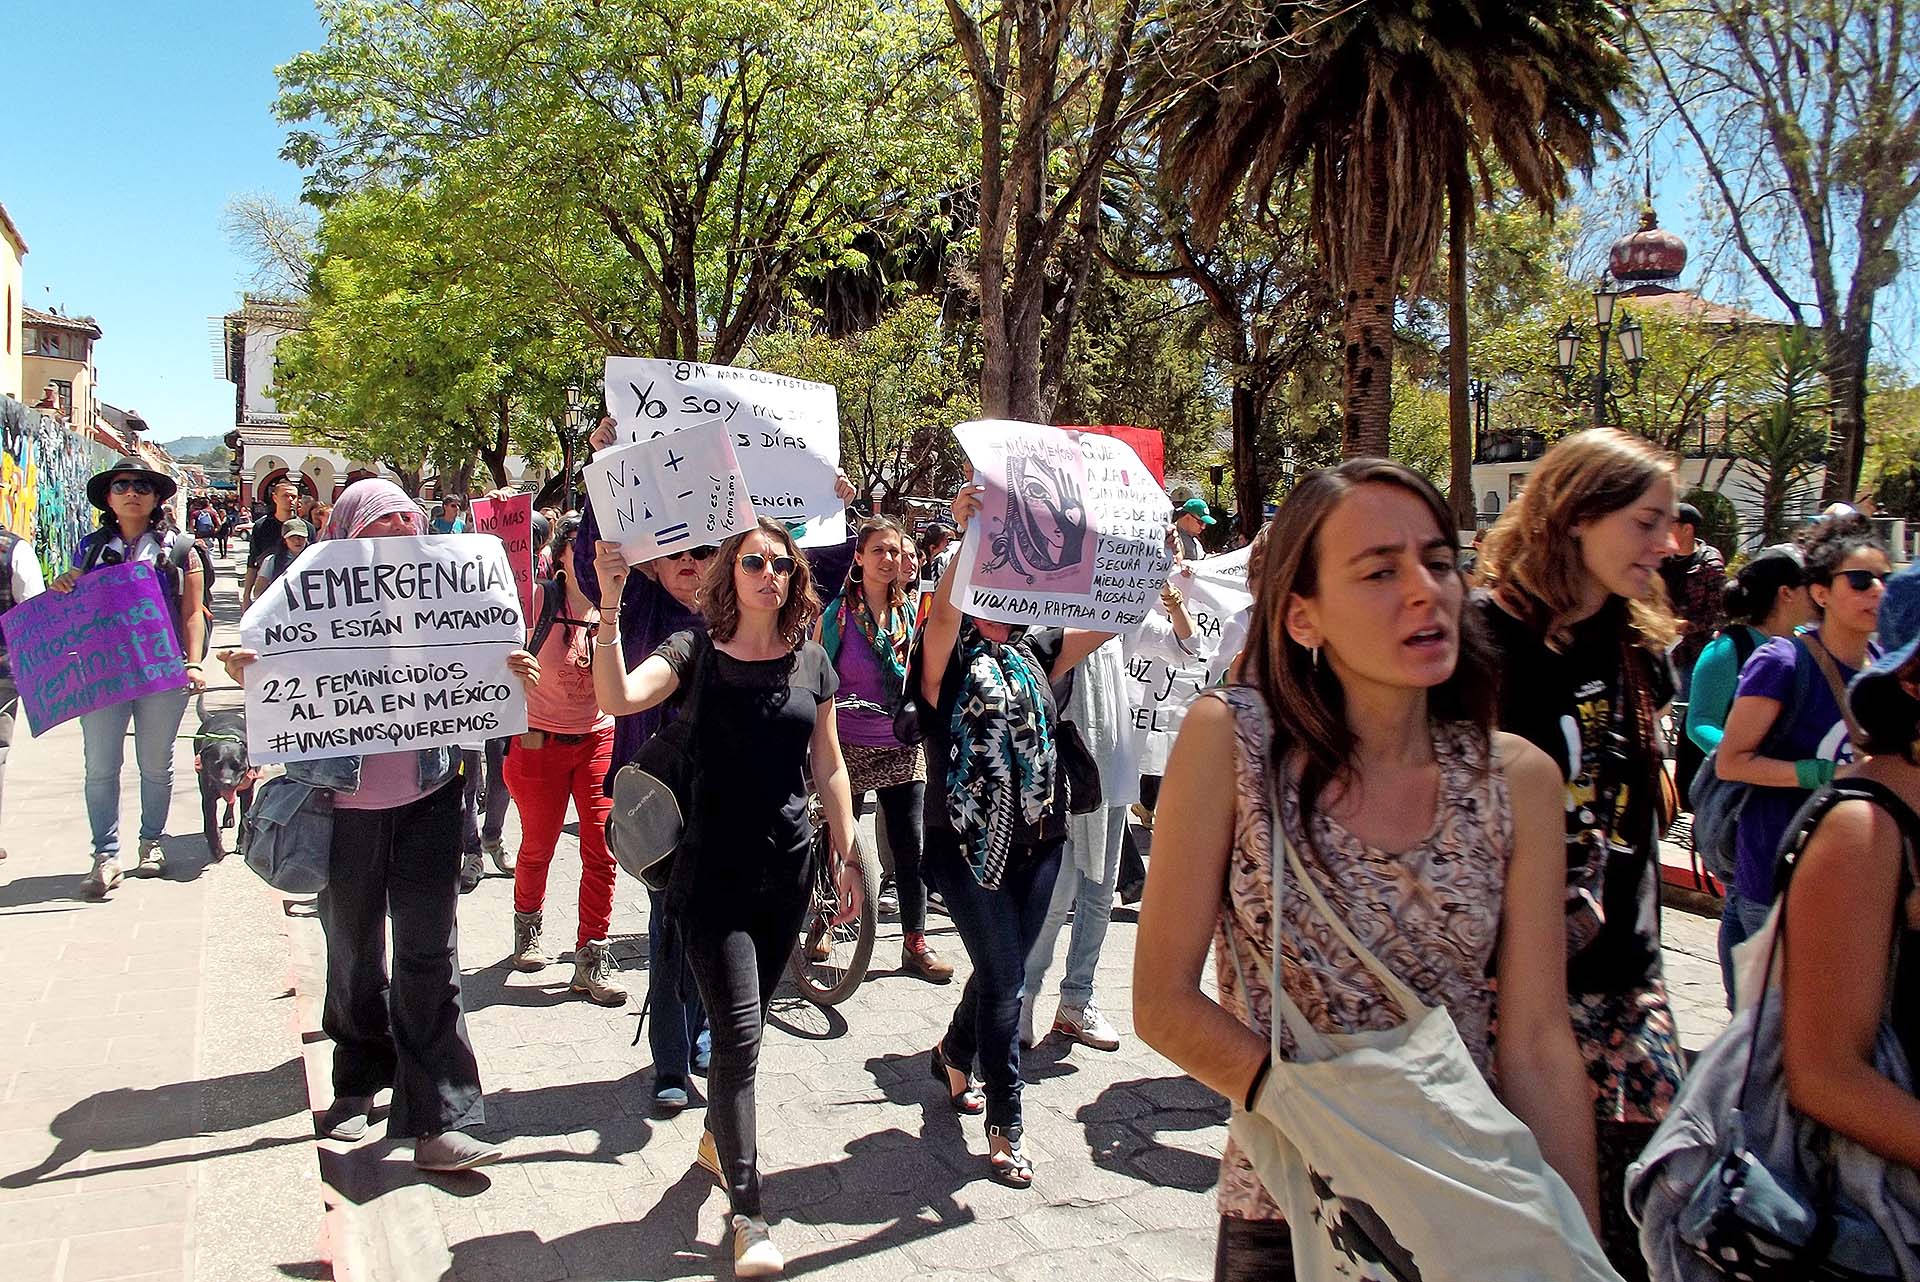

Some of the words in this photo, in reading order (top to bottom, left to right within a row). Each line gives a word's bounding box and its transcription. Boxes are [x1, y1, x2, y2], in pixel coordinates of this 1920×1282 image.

[519, 483, 538, 492] XXO
[710, 493, 718, 508] es
[720, 474, 735, 531] feminismo
[750, 491, 805, 508] ENCIA
[706, 513, 716, 531] eso
[1132, 508, 1145, 522] DE
[480, 516, 498, 531] NO
[1131, 525, 1145, 540] DE
[508, 540, 529, 553] CIA
[1097, 539, 1105, 553] Y
[1095, 557, 1141, 571] SEGURA
[1155, 560, 1171, 572] SIN
[515, 569, 529, 583] AS
[1093, 574, 1125, 589] MIEDO
[1127, 576, 1146, 589] DE
[1094, 589, 1146, 605] ACOSADA
[1044, 600, 1096, 619] RAPTADA
[1101, 609, 1111, 620] O
[264, 622, 318, 646] NOS
[331, 610, 404, 640] ESTÁN
[414, 606, 519, 631] MATANDO
[1125, 657, 1153, 684] UZ
[316, 662, 469, 698] FEMINICIDIOS
[290, 702, 324, 722] AL
[335, 690, 375, 717] DÍA
[381, 690, 415, 711] EN
[424, 681, 511, 711] MÉXICO
[1130, 706, 1163, 733] EL
[267, 711, 499, 754] #VIVASNOSQUEREMOS
